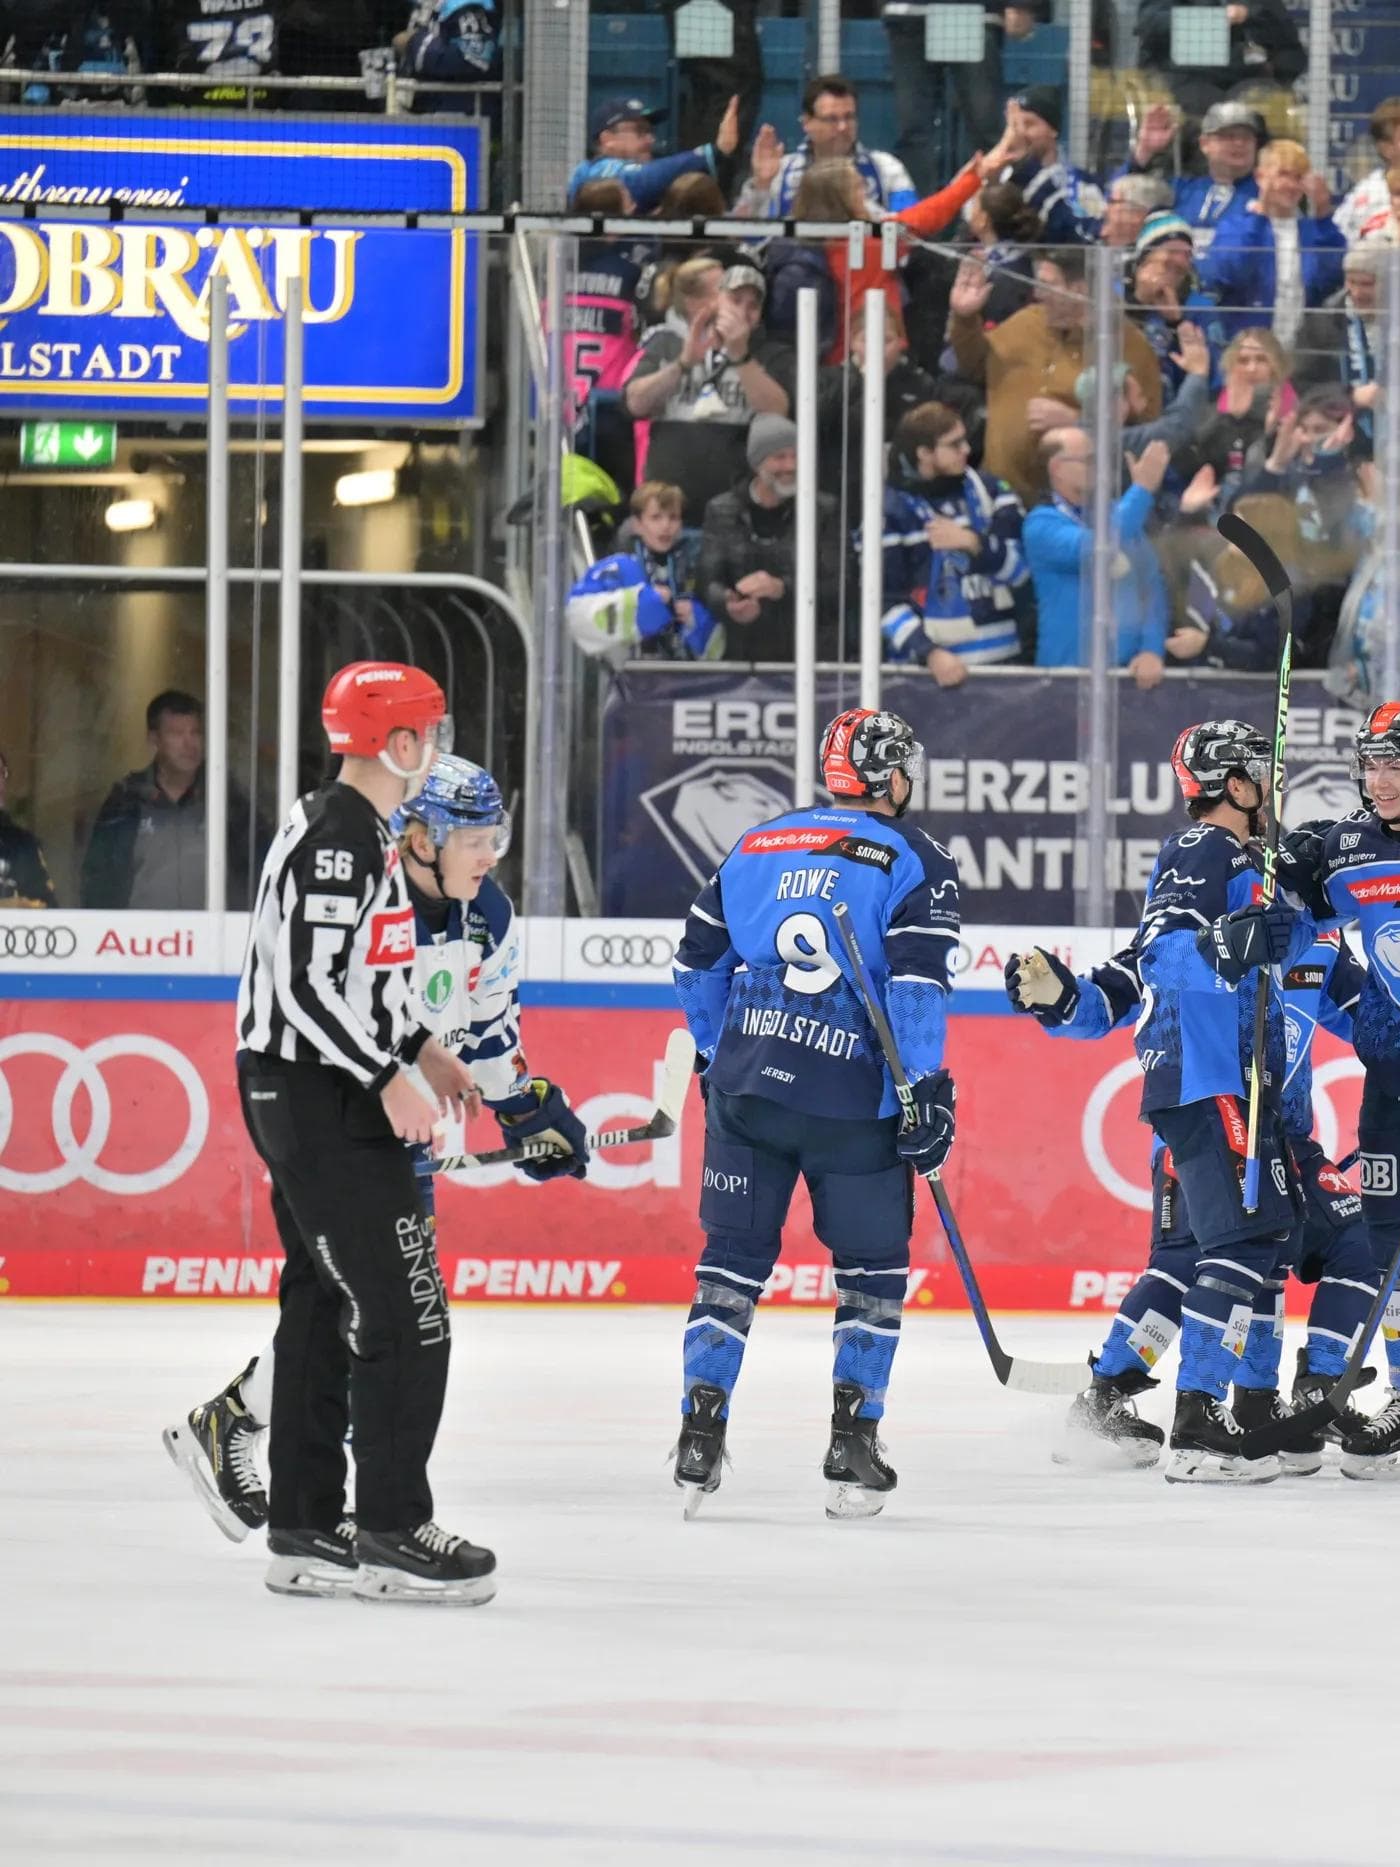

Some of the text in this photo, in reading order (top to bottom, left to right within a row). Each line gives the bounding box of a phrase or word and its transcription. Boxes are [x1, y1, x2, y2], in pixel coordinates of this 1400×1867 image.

[314, 850, 353, 880] 56
[776, 868, 841, 902] ROWE
[95, 929, 194, 957] Audi
[776, 911, 843, 994] 9
[742, 1007, 860, 1061] INGOLSTADT
[395, 1213, 445, 1347] LINDNER
